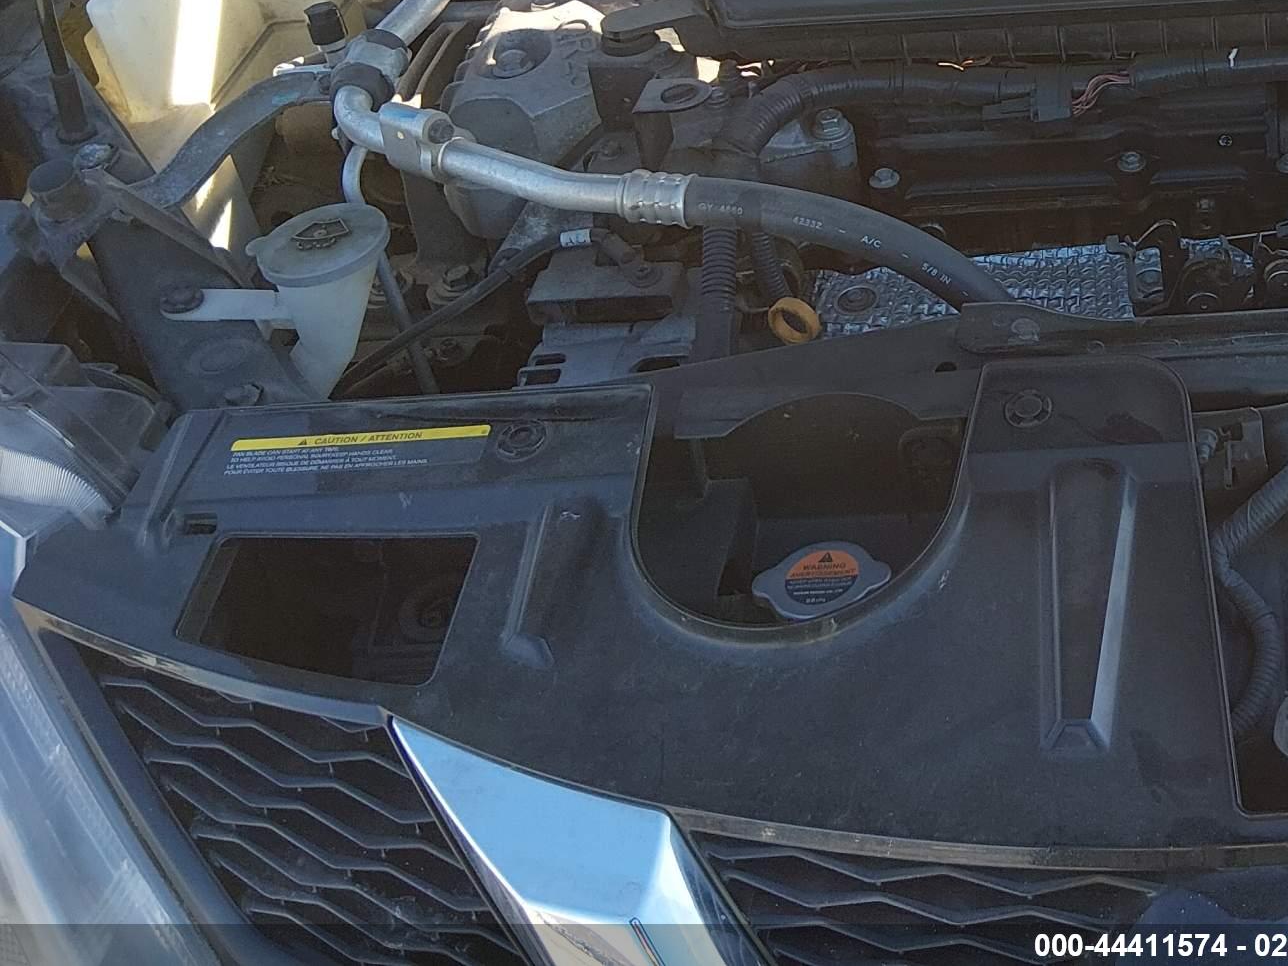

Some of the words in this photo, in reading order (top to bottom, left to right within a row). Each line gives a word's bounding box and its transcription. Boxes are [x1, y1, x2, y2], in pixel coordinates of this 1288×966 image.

[792, 215, 823, 230] 42332
[860, 235, 882, 249] A/C
[921, 262, 938, 276] 5/8
[939, 273, 952, 286] IN
[314, 436, 358, 445] CAUTION
[368, 431, 423, 441] ATTENTION
[803, 562, 846, 570] WARNING
